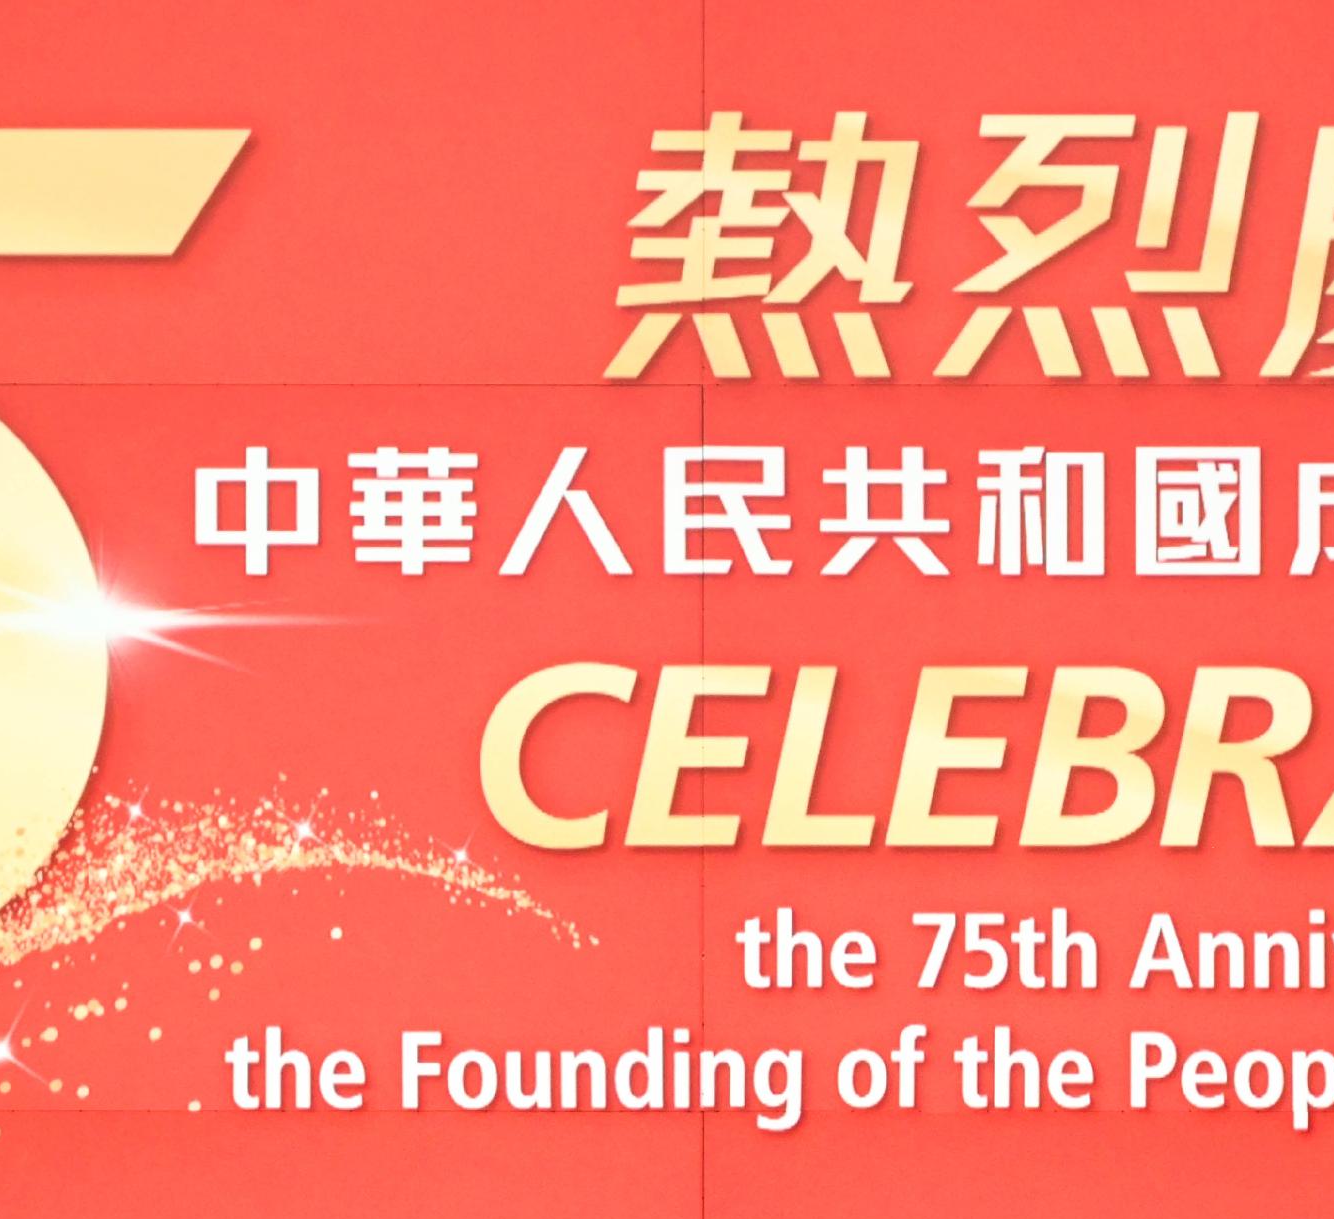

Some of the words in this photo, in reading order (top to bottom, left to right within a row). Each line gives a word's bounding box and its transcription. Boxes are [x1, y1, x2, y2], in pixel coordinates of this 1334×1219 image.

[735, 907, 877, 989] the
[911, 907, 1098, 989] 75th
[224, 1025, 366, 1110] the
[401, 1025, 803, 1131] Founding
[837, 1024, 927, 1109] of
[953, 1026, 1094, 1109] the
